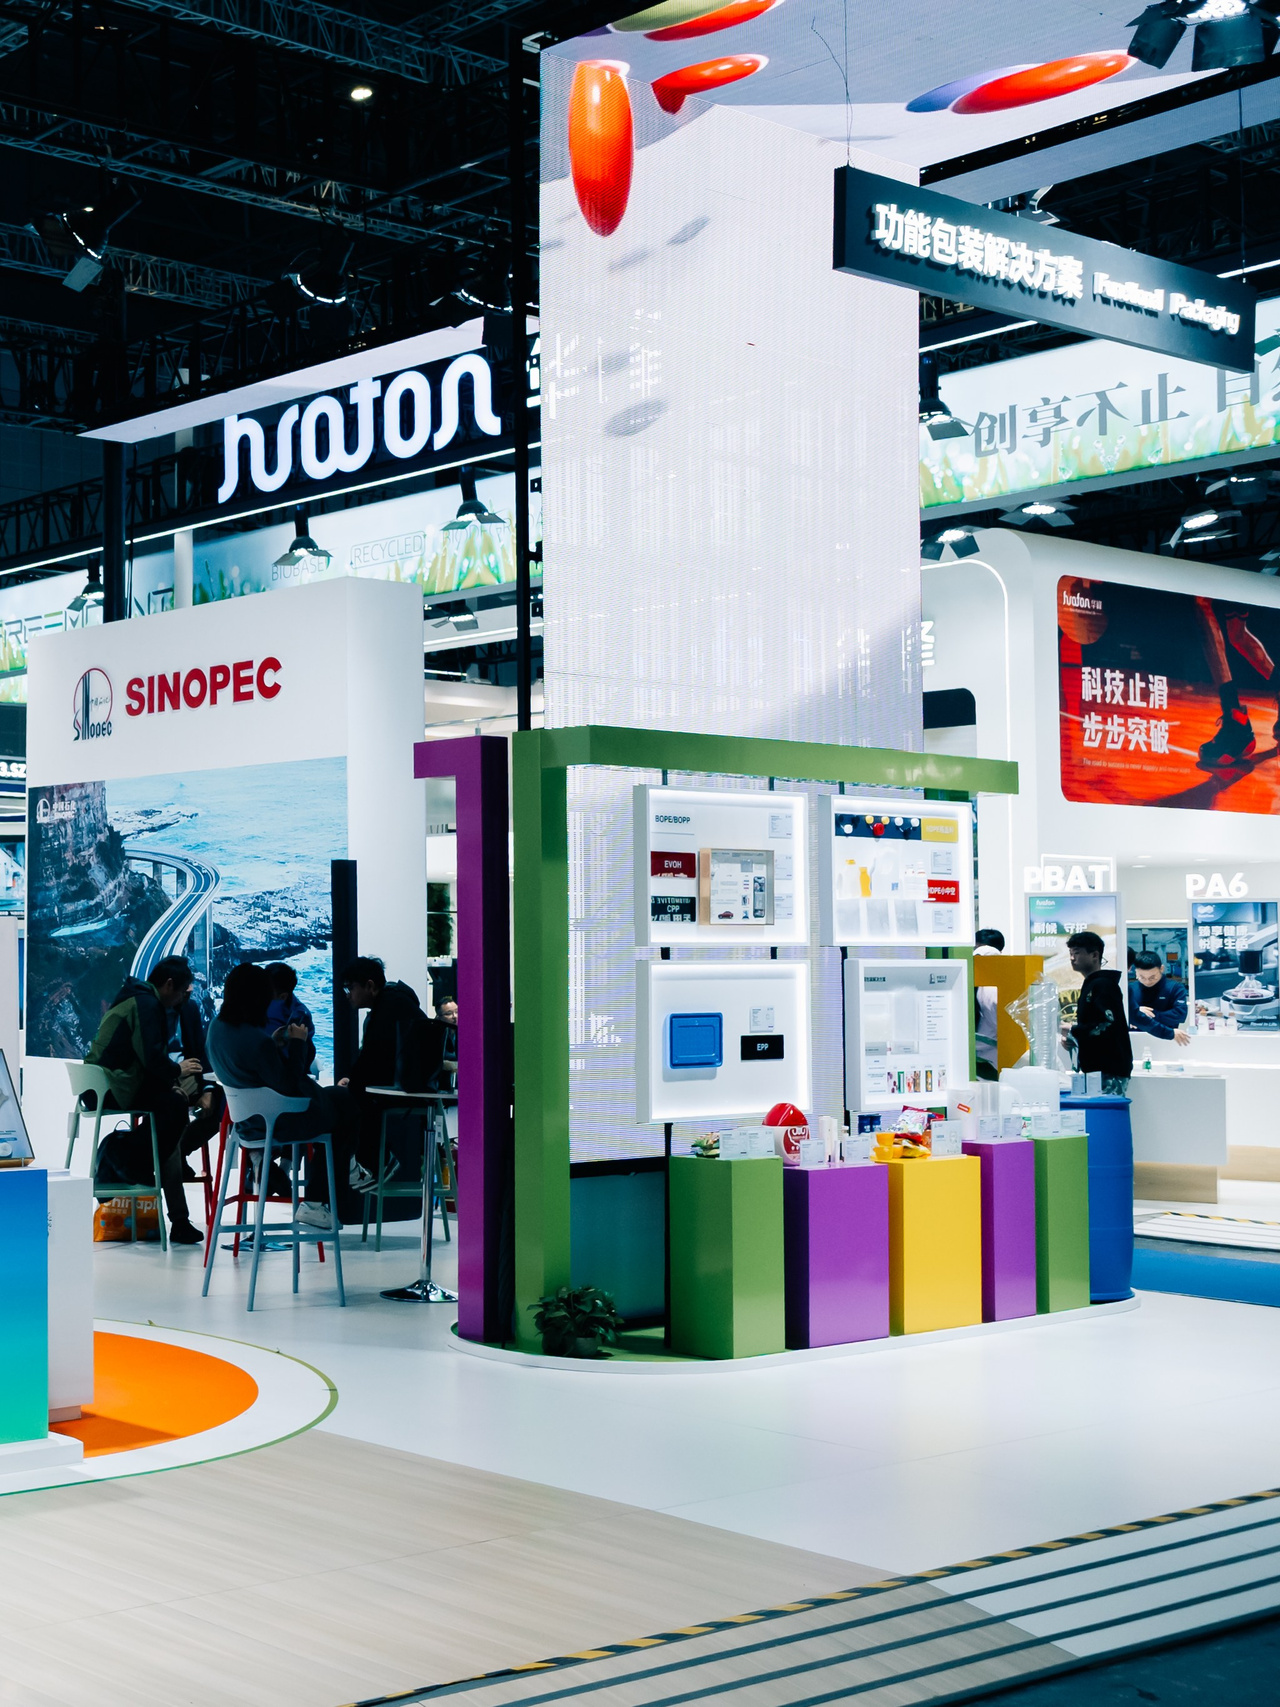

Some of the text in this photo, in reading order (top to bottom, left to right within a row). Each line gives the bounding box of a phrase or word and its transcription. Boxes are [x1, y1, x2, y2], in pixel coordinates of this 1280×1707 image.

[872, 203, 1084, 299] 功能包装解决方案
[1169, 292, 1241, 335] Packaging
[972, 371, 1191, 458] 创享不止
[353, 534, 423, 566] RECYCLED
[125, 656, 282, 717] SINOPEC
[1081, 666, 1168, 711] 科技止滑
[1082, 711, 1170, 755] 步步突破
[655, 814, 691, 824] BOPE/BOPP
[664, 860, 682, 869] EVOH
[1023, 865, 1109, 892] PBAT
[1185, 872, 1249, 899] PA6
[667, 904, 680, 913] CPP
[757, 1043, 769, 1051] EPP
